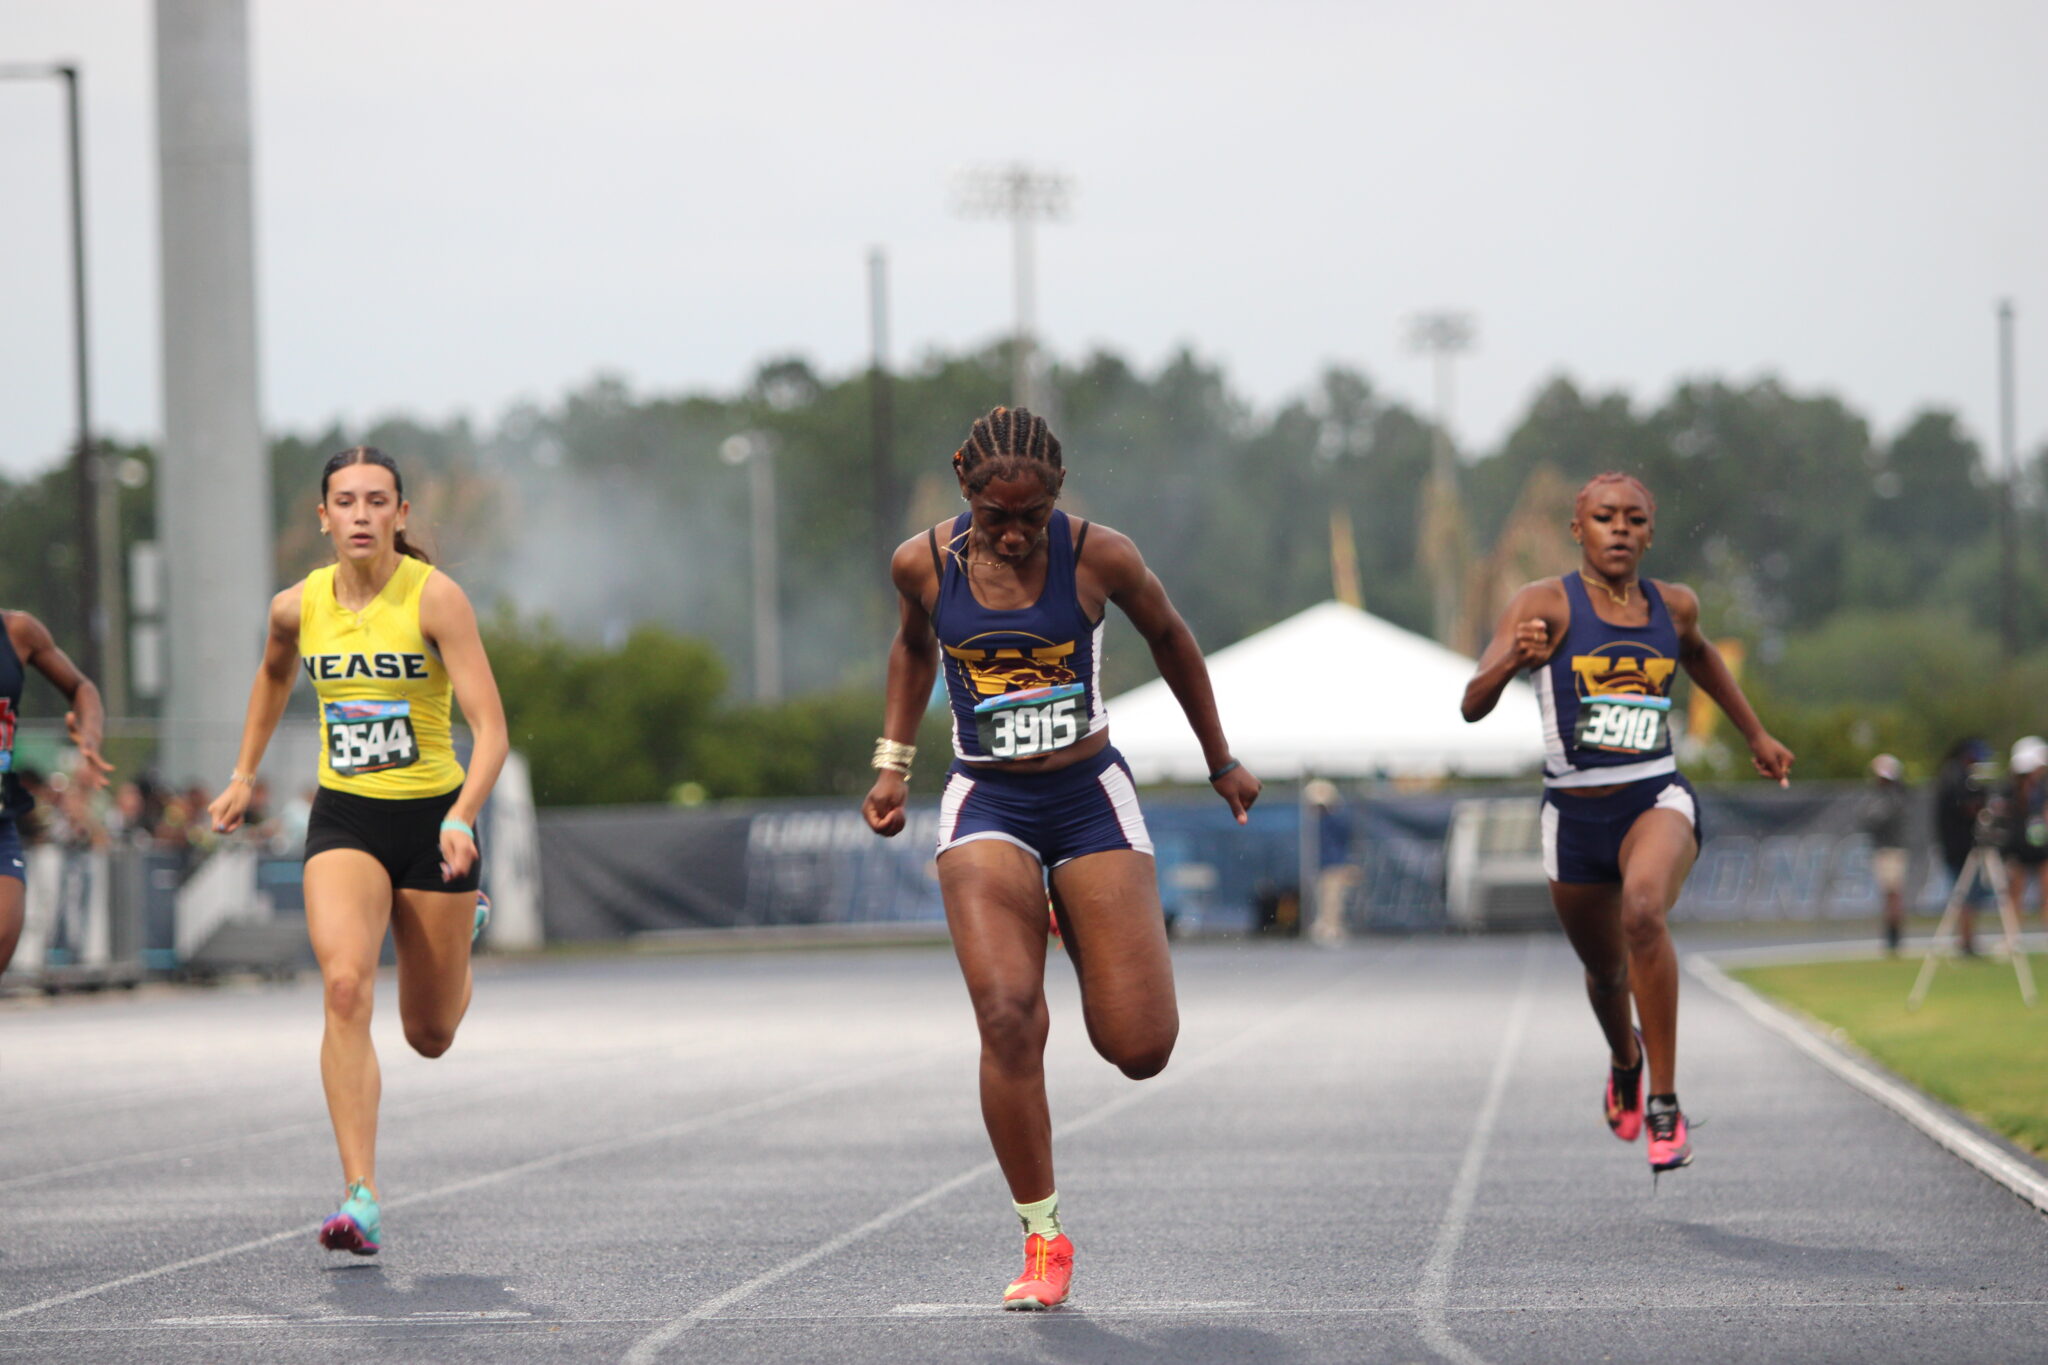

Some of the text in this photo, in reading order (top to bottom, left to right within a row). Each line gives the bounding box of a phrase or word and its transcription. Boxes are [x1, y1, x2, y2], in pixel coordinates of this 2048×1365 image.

[330, 718, 413, 768] 3544
[991, 697, 1077, 757] 3915
[1581, 702, 1660, 751] 3910
